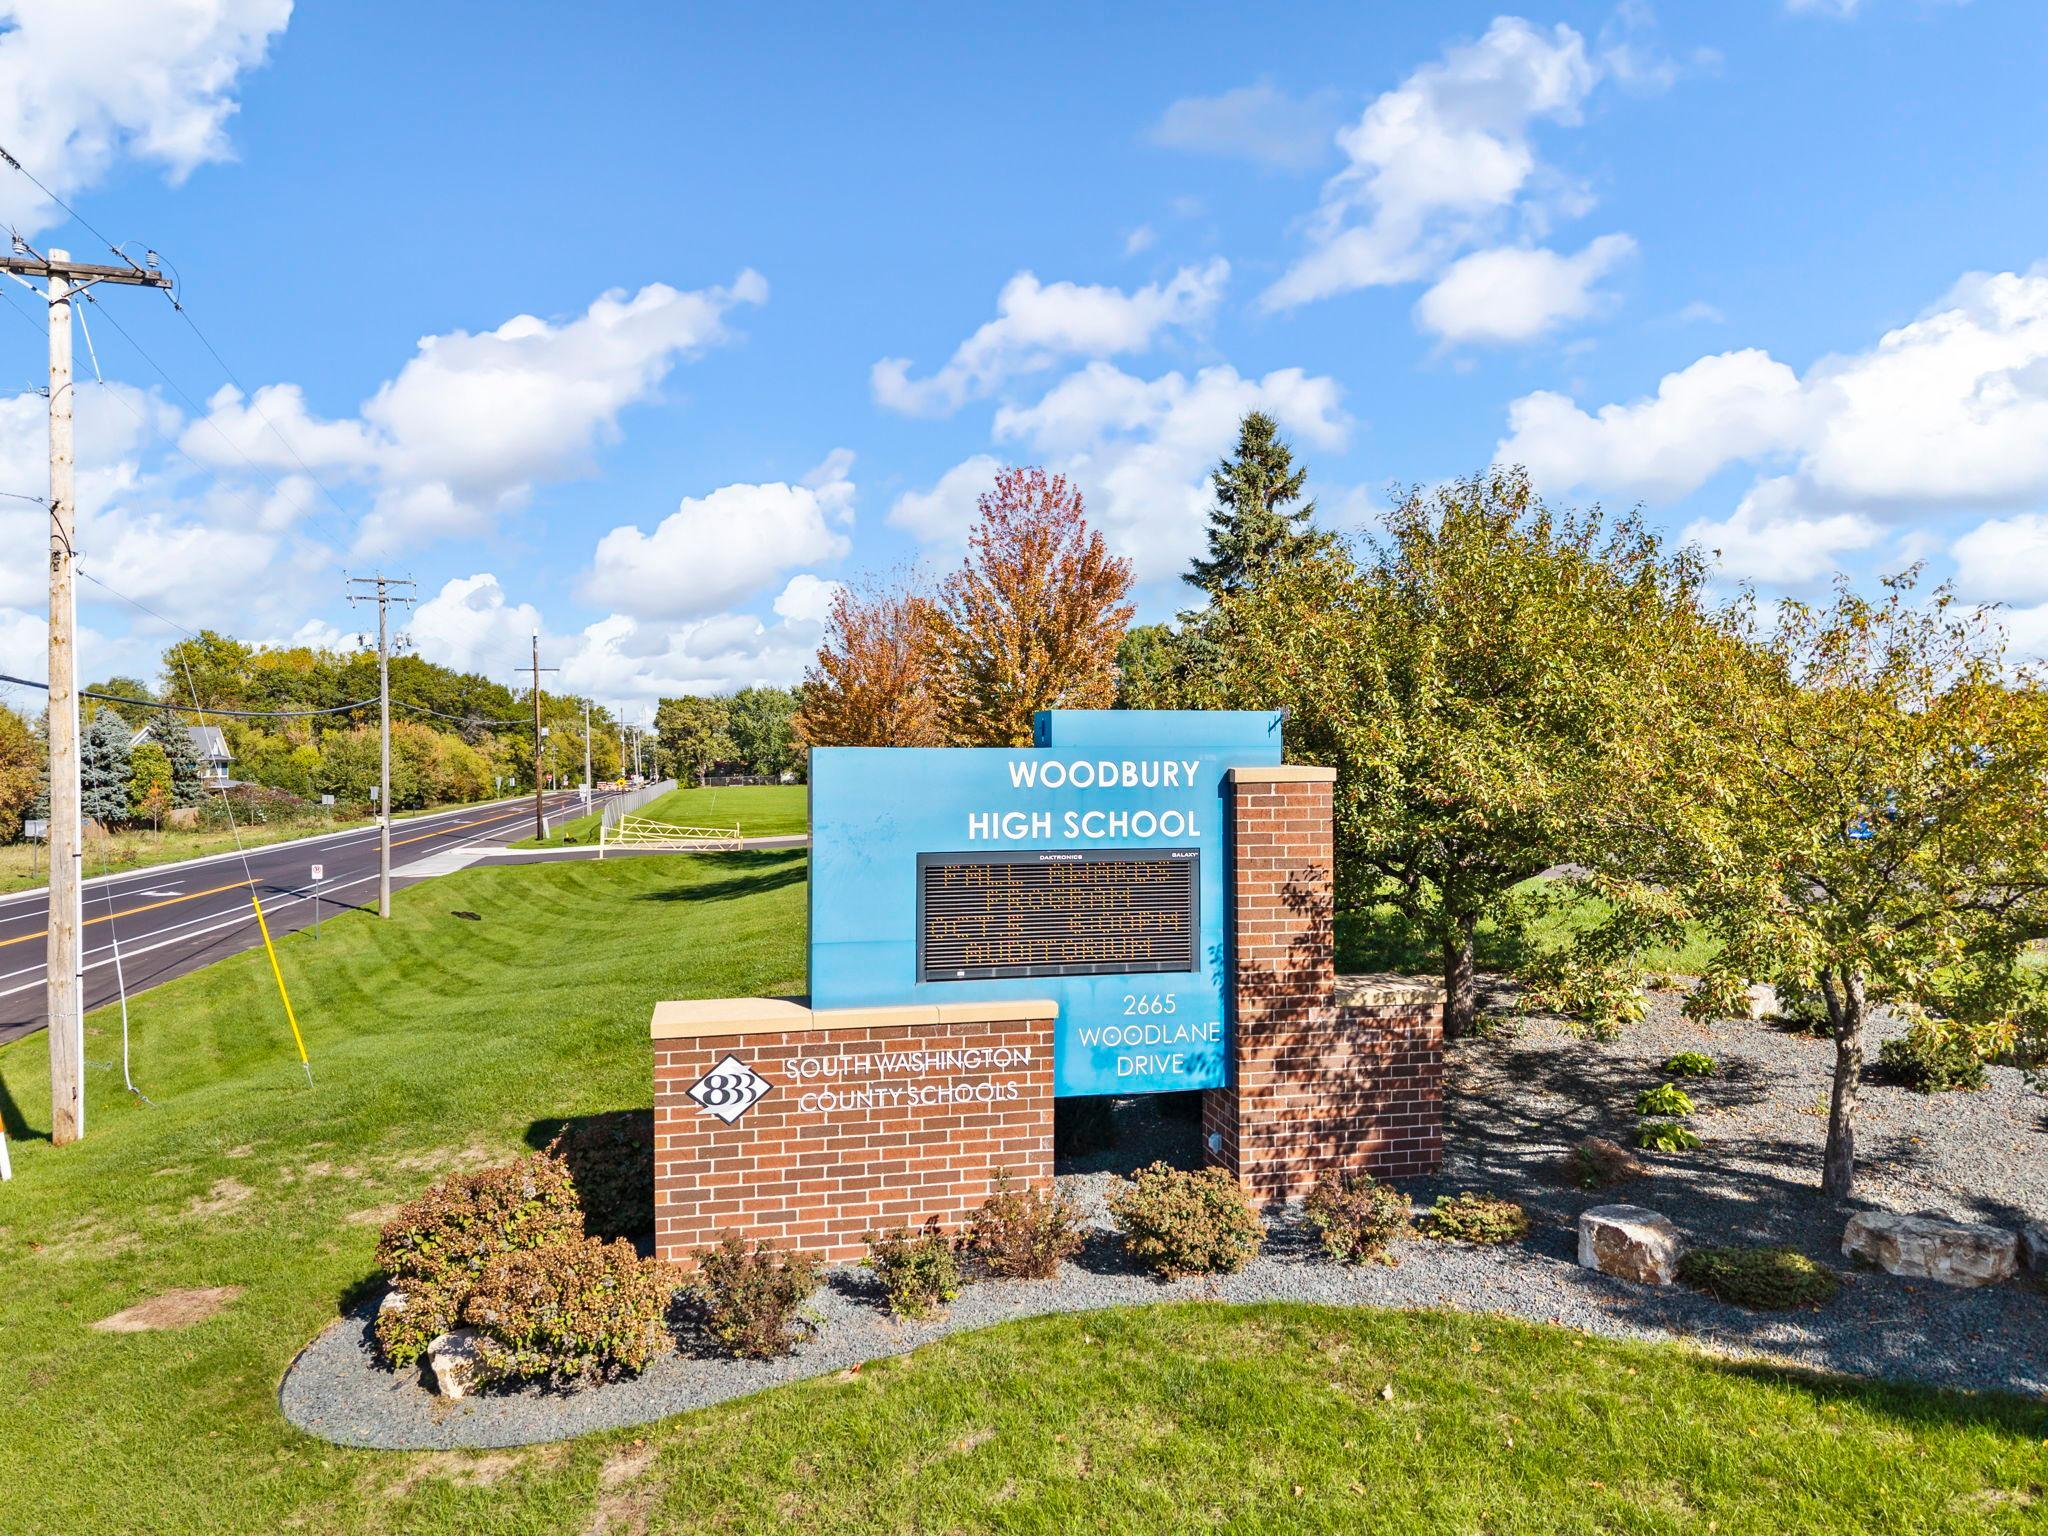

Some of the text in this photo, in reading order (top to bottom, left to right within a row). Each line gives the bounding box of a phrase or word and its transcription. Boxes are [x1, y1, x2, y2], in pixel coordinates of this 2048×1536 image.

[1008, 760, 1200, 788] WOODBURY
[968, 810, 1200, 839] HIGH SCHOOL
[944, 861, 1170, 887] FALL AWARDS
[986, 887, 1130, 912] PROGRAM
[965, 937, 1150, 964] AUDITORIUM
[1123, 993, 1176, 1015] 2665
[1078, 1022, 1220, 1047] WOODLANE
[786, 1048, 1029, 1078] SOUTH WASHINGTON
[1117, 1053, 1184, 1077] DRIVE
[702, 1073, 757, 1106] 833
[800, 1081, 1018, 1112] COUNTY SCHOOLS
